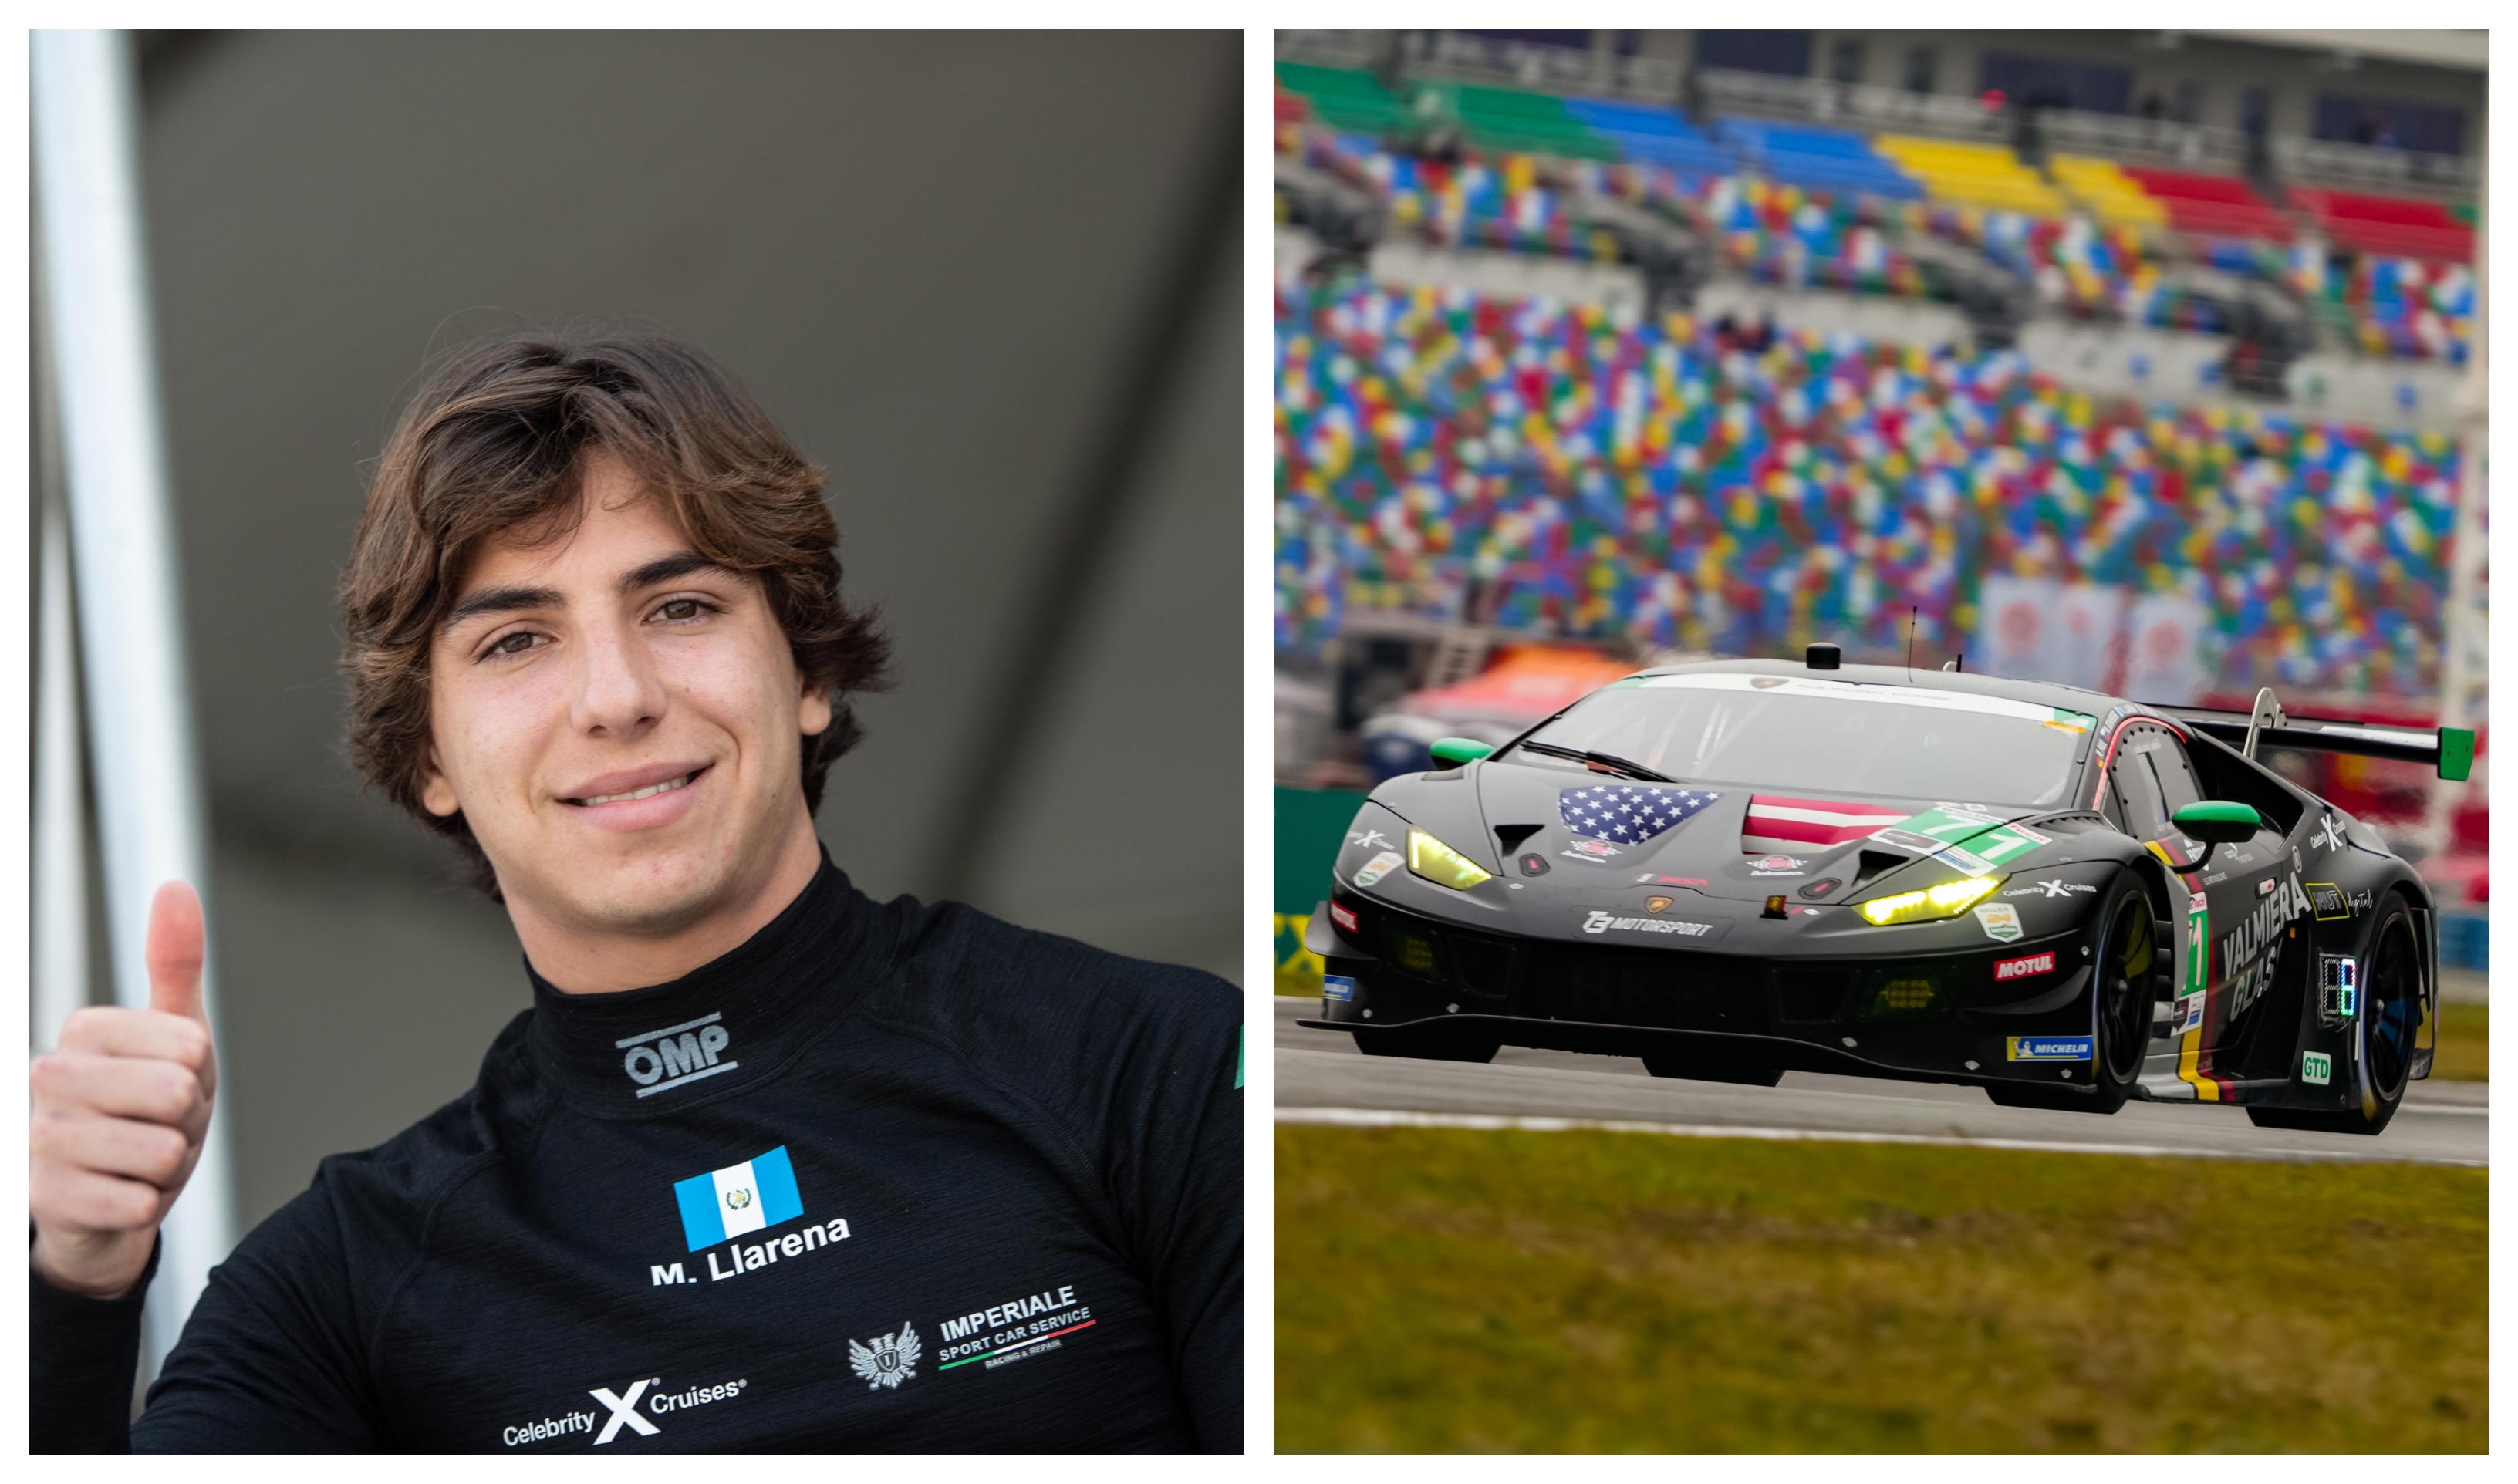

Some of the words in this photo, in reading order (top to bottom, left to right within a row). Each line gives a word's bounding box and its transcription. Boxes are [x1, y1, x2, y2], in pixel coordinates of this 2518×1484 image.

[1921, 815, 2029, 860] 71
[2320, 813, 2343, 852] X
[2003, 885, 2045, 897] Celebrity
[2037, 879, 2073, 898] X
[2063, 883, 2098, 893] Cruises
[1609, 916, 1714, 937] MOTORSPORT
[2223, 870, 2312, 982] VALMIERA
[1997, 955, 2053, 979] MOTUL
[623, 1024, 730, 1085] OMP
[2034, 1044, 2088, 1054] MICHELIN
[2304, 1056, 2329, 1079] GTD
[650, 1262, 697, 1286] M.
[707, 1217, 852, 1282] Llarena
[939, 1284, 1078, 1342] IMPERIALE
[938, 1336, 991, 1361] SPORT
[994, 1326, 1028, 1345] CAR
[1028, 1307, 1092, 1334] SERVICE
[985, 1350, 1021, 1369] RACING
[1028, 1339, 1062, 1356] REPAIR
[502, 1411, 596, 1446] Celebrity
